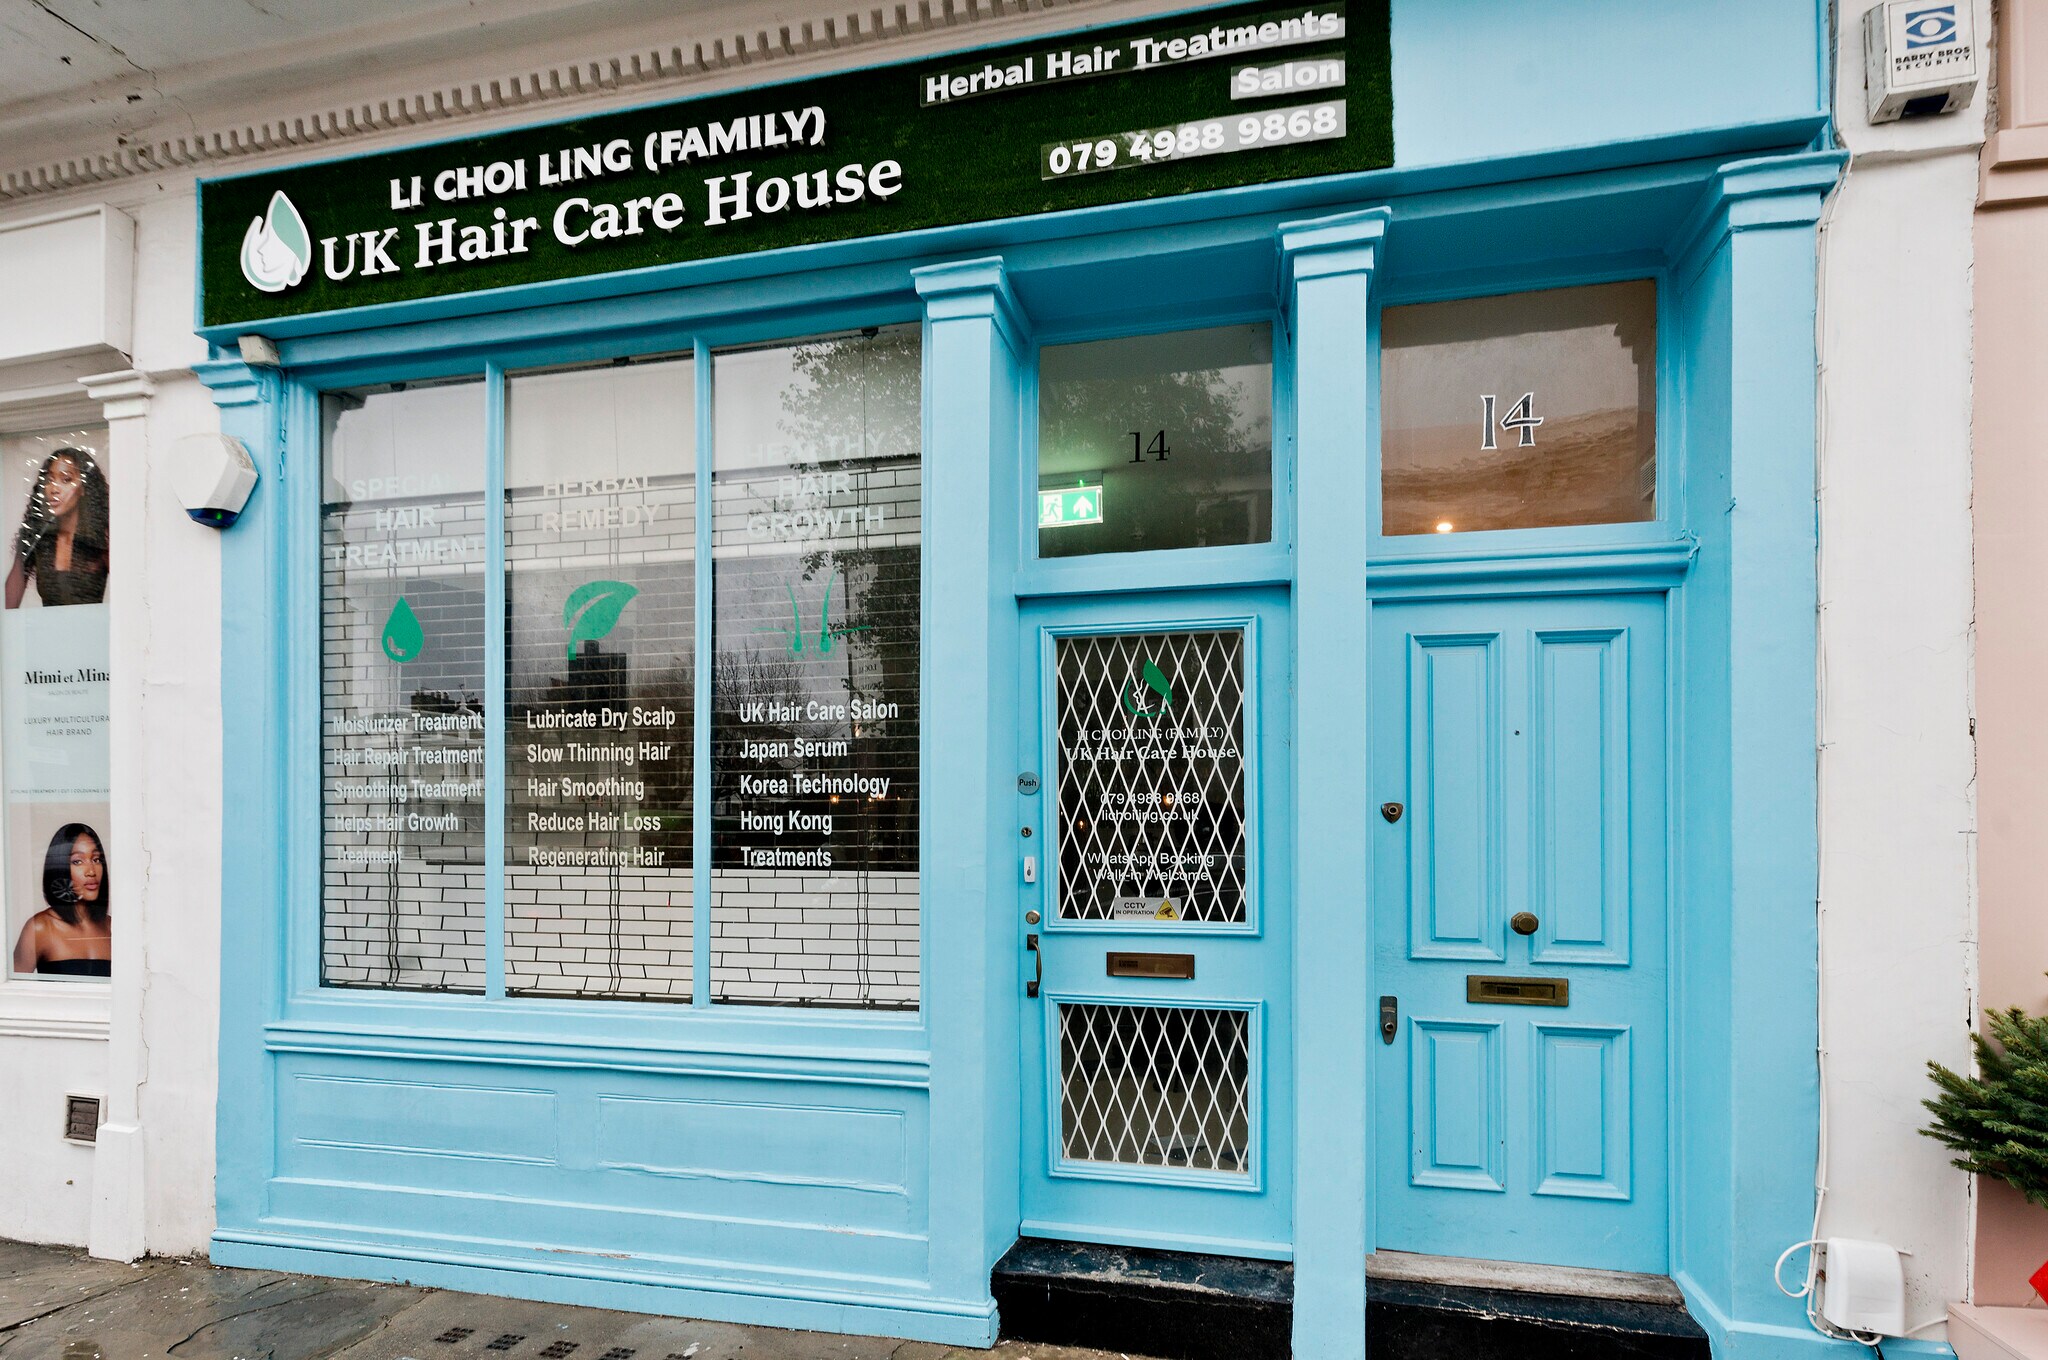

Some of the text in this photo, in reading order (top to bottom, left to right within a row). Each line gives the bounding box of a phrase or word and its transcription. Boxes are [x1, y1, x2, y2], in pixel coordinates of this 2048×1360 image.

[926, 11, 1339, 103] Herbal Hair Treatments
[1895, 46, 1970, 64] BARRY BROS
[1896, 55, 1970, 72] SECURITY
[1237, 60, 1340, 95] Salon
[1049, 106, 1338, 175] 079 4988 9868
[390, 106, 826, 210] LI CHOI LING (FAMILY)
[320, 159, 903, 280] UK Hair Care House
[1480, 392, 1544, 450] 14
[1129, 430, 1170, 463] 14
[777, 473, 852, 501] HAIR
[375, 507, 437, 532] HAIR
[541, 504, 660, 533] REMEDY
[747, 506, 885, 539] GROWTH
[330, 537, 484, 568] TREATMENT
[24, 670, 61, 685] Mimi
[64, 675, 74, 683] et
[24, 717, 51, 725] LUXURY
[333, 712, 483, 734] Moisturizer Treatment
[526, 706, 676, 732] Lubricate Dry Scalp
[739, 699, 899, 723] UK Hair Care Salon
[66, 728, 92, 736] BRAND
[1091, 728, 1126, 740] CHOI
[1129, 728, 1162, 740] LING
[333, 746, 483, 769] Hair Repair Treatment
[527, 741, 671, 766] Slow Thinning Hair
[739, 737, 848, 763] Japan Serum
[1065, 745, 1236, 761] UK Hair Care House
[334, 779, 482, 803] Smoothing Treatment
[527, 776, 645, 801] Hair Smoothing
[740, 773, 890, 798] Korea Technology
[1019, 778, 1037, 787] Push
[1100, 793, 1125, 804] 079
[1130, 792, 1162, 804] 4988
[334, 812, 459, 835] Helps Hair Growth
[528, 811, 661, 831] Reduce Hair Loss
[741, 810, 832, 835] Hong Kong
[1102, 809, 1199, 824] lichoiling.co.uk
[334, 847, 403, 865] Treatment
[528, 846, 665, 868] Regenerating Hair
[740, 846, 832, 867] Treatments
[1160, 852, 1214, 868] Booking
[1093, 868, 1209, 881] Walk-in Welcome
